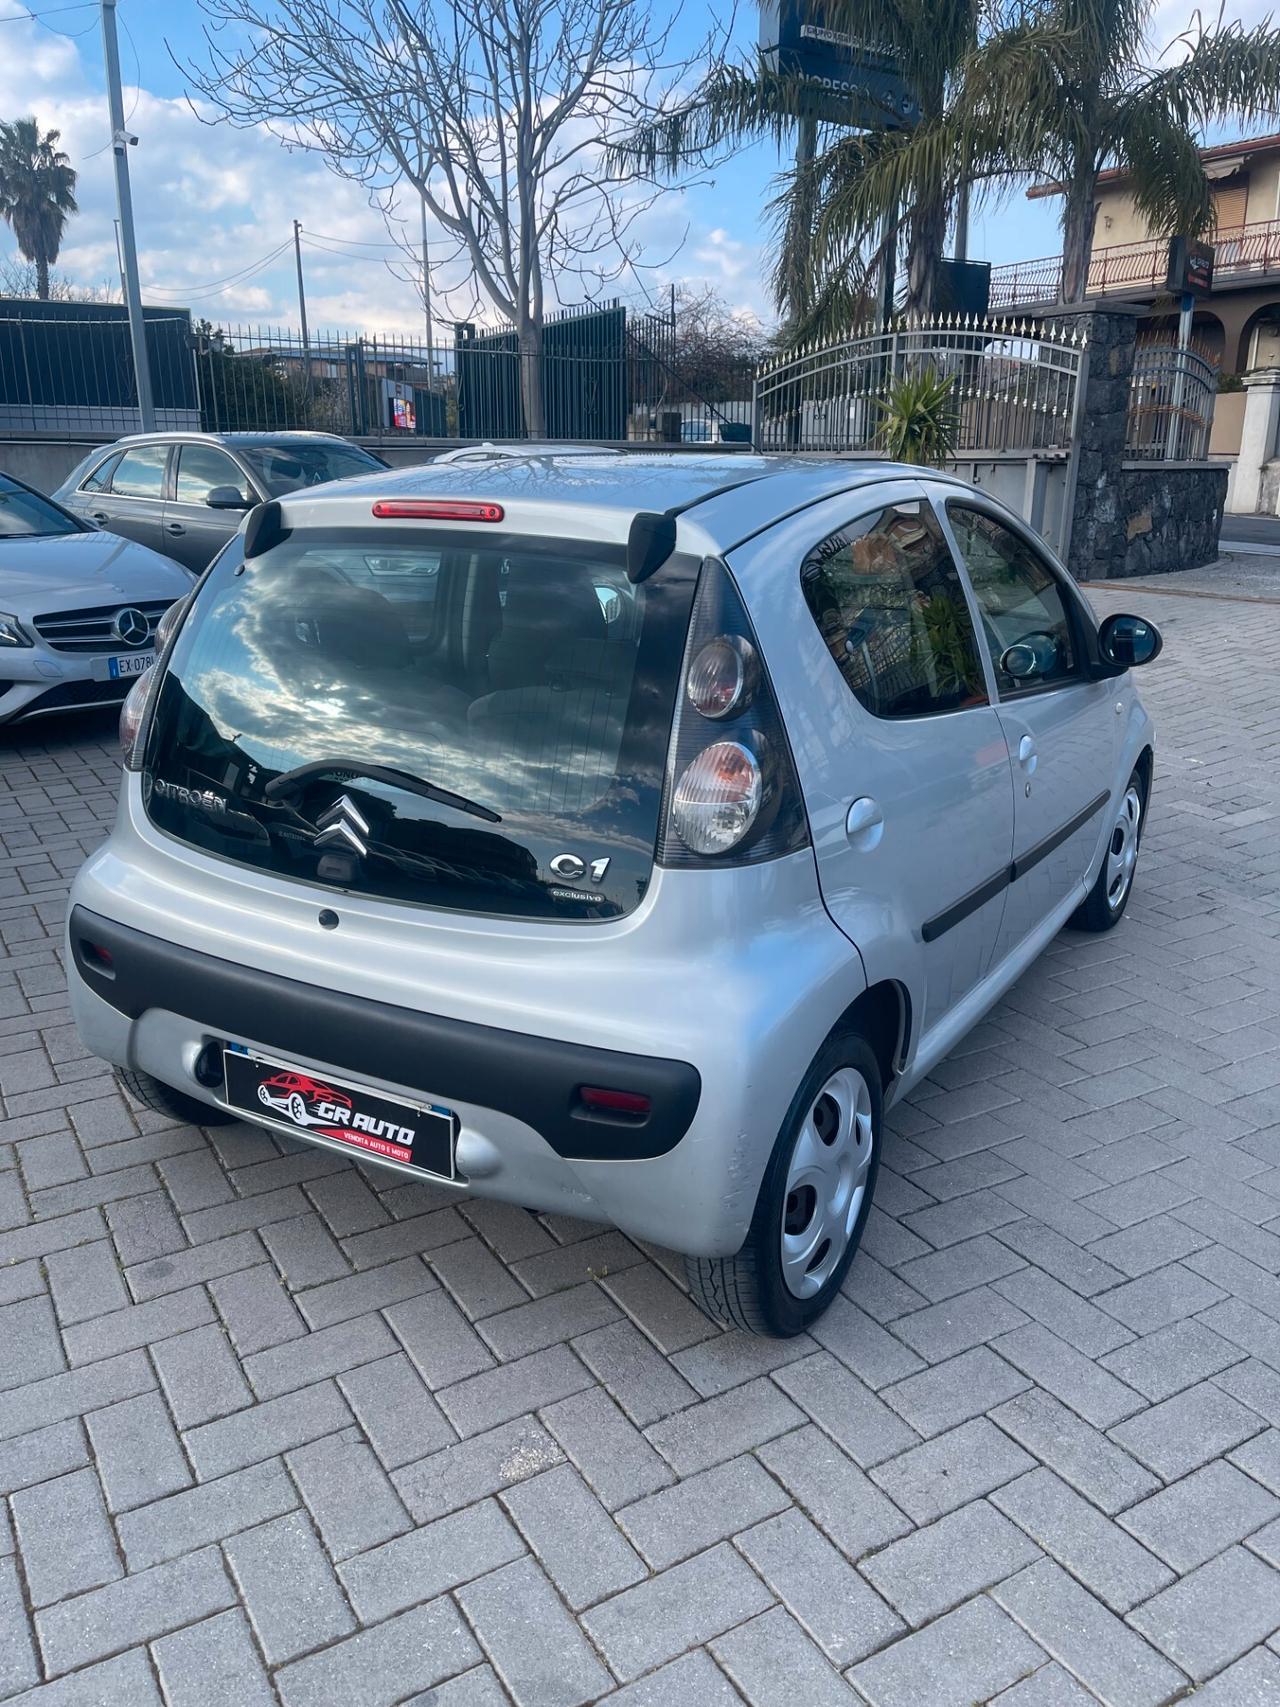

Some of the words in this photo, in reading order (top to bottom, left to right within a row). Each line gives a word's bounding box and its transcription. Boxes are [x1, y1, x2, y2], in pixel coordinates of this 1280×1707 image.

[119, 659, 132, 673] EX
[550, 854, 611, 882] C1
[317, 1102, 350, 1125] GR
[352, 1113, 415, 1145] AUTO
[343, 1132, 369, 1145] VENDITA
[369, 1142, 386, 1151] AUTO
[386, 1145, 391, 1153] E
[391, 1148, 409, 1159] MOTO
